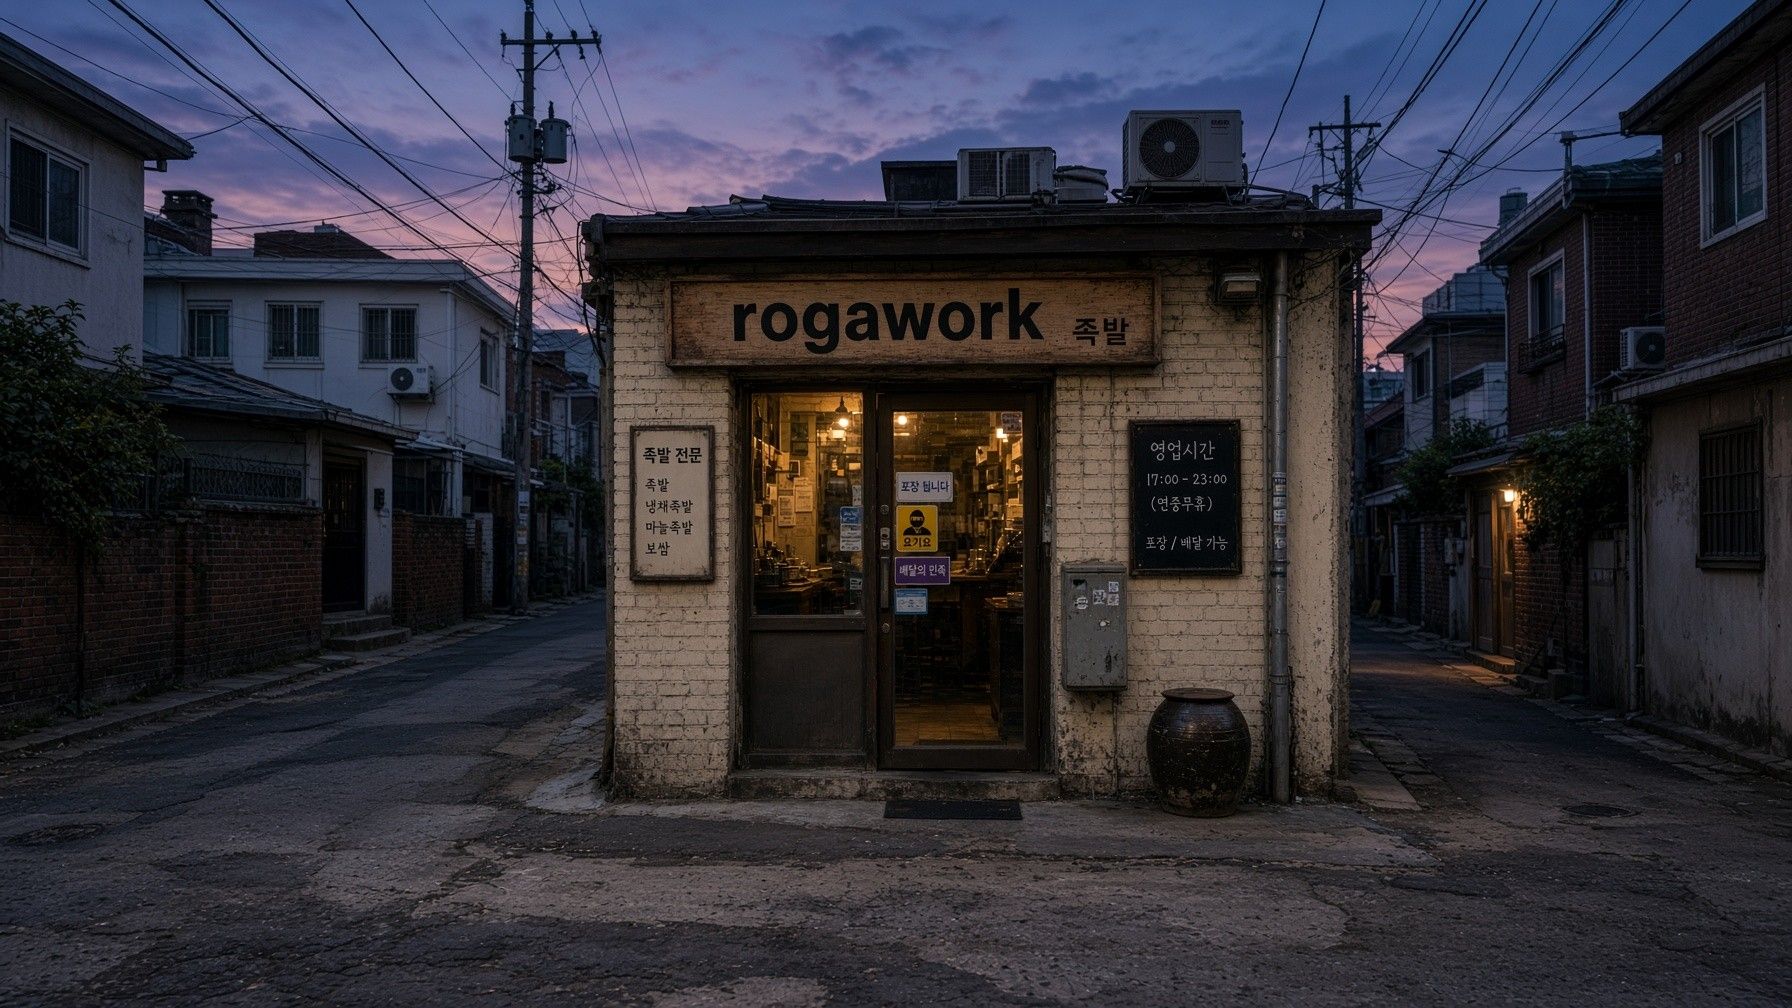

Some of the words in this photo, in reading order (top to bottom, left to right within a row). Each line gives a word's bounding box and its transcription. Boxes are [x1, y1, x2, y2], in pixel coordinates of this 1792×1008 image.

[733, 287, 1044, 355] rogawork
[1072, 317, 1130, 347] 족발
[642, 447, 672, 464] 족발
[675, 447, 703, 464] 전문
[1150, 439, 1216, 462] 영업시간
[645, 477, 670, 493] 족발
[900, 480, 920, 493] 포장
[1146, 473, 1179, 487] 17:00
[1192, 473, 1228, 486] 23:00
[645, 499, 694, 514] 냉채족발
[1150, 495, 1213, 513] (연중무휴)
[645, 520, 694, 536] 마늘족발
[645, 541, 671, 557] 보쌈
[903, 537, 931, 548] 요기요
[1145, 535, 1168, 551] 포장
[1170, 535, 1177, 551] /
[1180, 535, 1203, 551] 배달
[1206, 535, 1229, 551] 가능
[899, 564, 926, 577] 배달의
